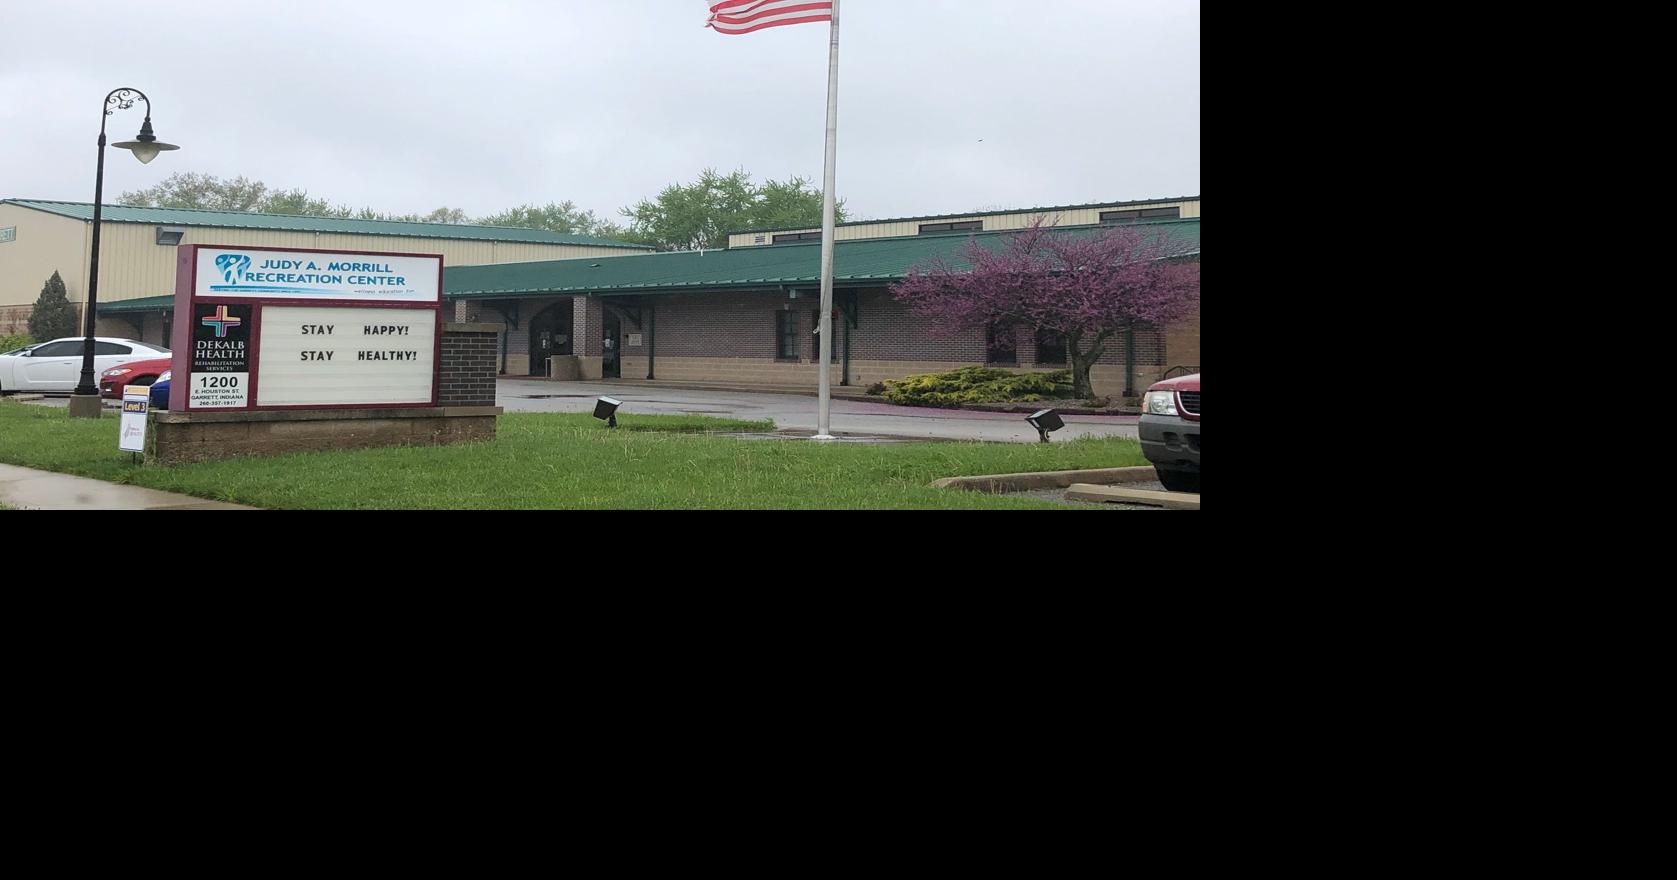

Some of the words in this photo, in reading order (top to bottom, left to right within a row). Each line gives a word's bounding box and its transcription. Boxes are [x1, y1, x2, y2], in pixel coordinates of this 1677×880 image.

[260, 260, 302, 270] JUDY
[306, 261, 321, 270] A.
[328, 262, 393, 273] MORRILL
[245, 272, 342, 284] RECREATION
[348, 275, 406, 286] CENTER
[301, 325, 334, 335] STAY
[363, 326, 409, 336] HAPPY!
[197, 340, 245, 349] DEKALB
[196, 350, 244, 358] HEALTH
[300, 351, 334, 361] STAY
[358, 351, 417, 361] HEALTHY!
[200, 376, 238, 388] 1200
[124, 402, 140, 411] Level
[140, 403, 146, 412] 3
